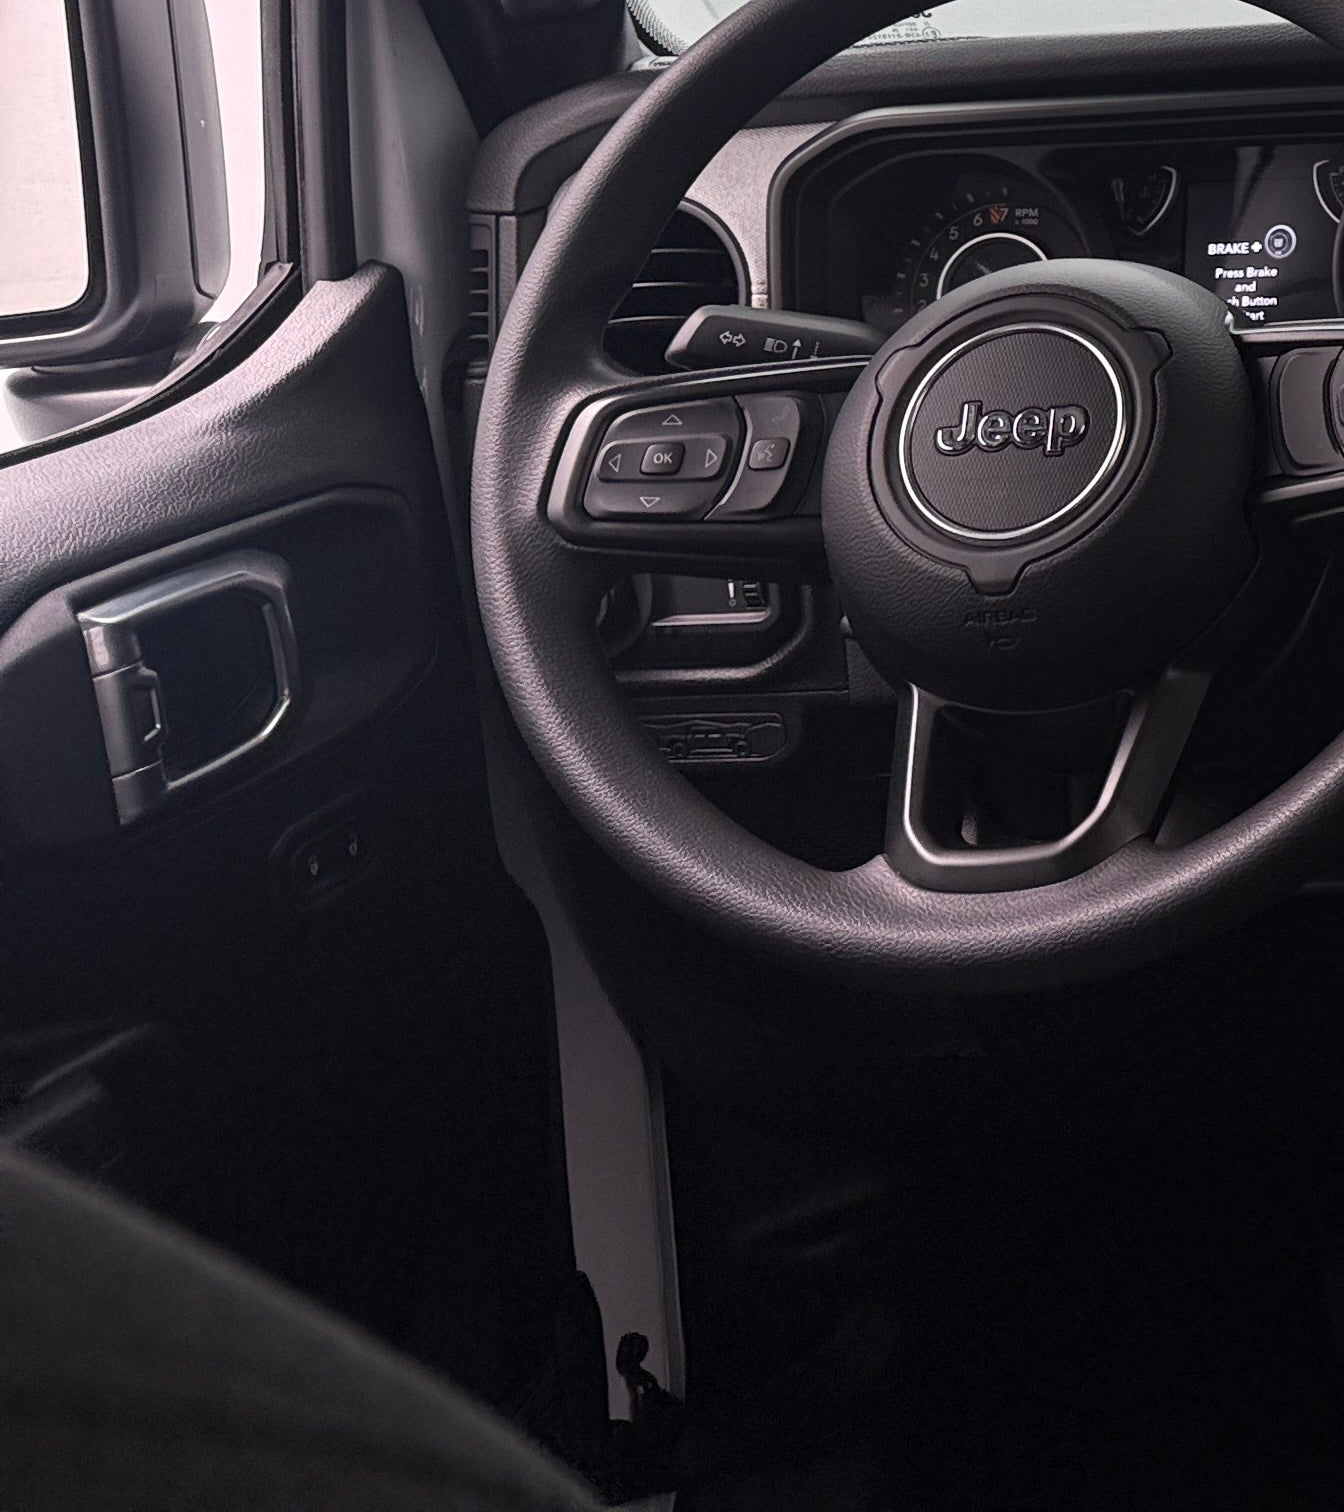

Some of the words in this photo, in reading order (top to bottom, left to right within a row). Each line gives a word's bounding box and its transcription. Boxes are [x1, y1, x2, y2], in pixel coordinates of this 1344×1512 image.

[973, 212, 983, 227] 6
[1015, 208, 1039, 218] RPM
[949, 226, 960, 240] 5
[930, 248, 940, 262] 4
[1207, 242, 1250, 256] BRAKE
[1215, 267, 1245, 279] Press
[1246, 266, 1278, 278] Brake
[919, 273, 929, 287] 3
[1234, 281, 1257, 293] and
[1241, 295, 1278, 307] Button
[935, 400, 1090, 457] Jeep
[653, 452, 673, 465] OK
[962, 607, 1038, 627] AIRBAG
